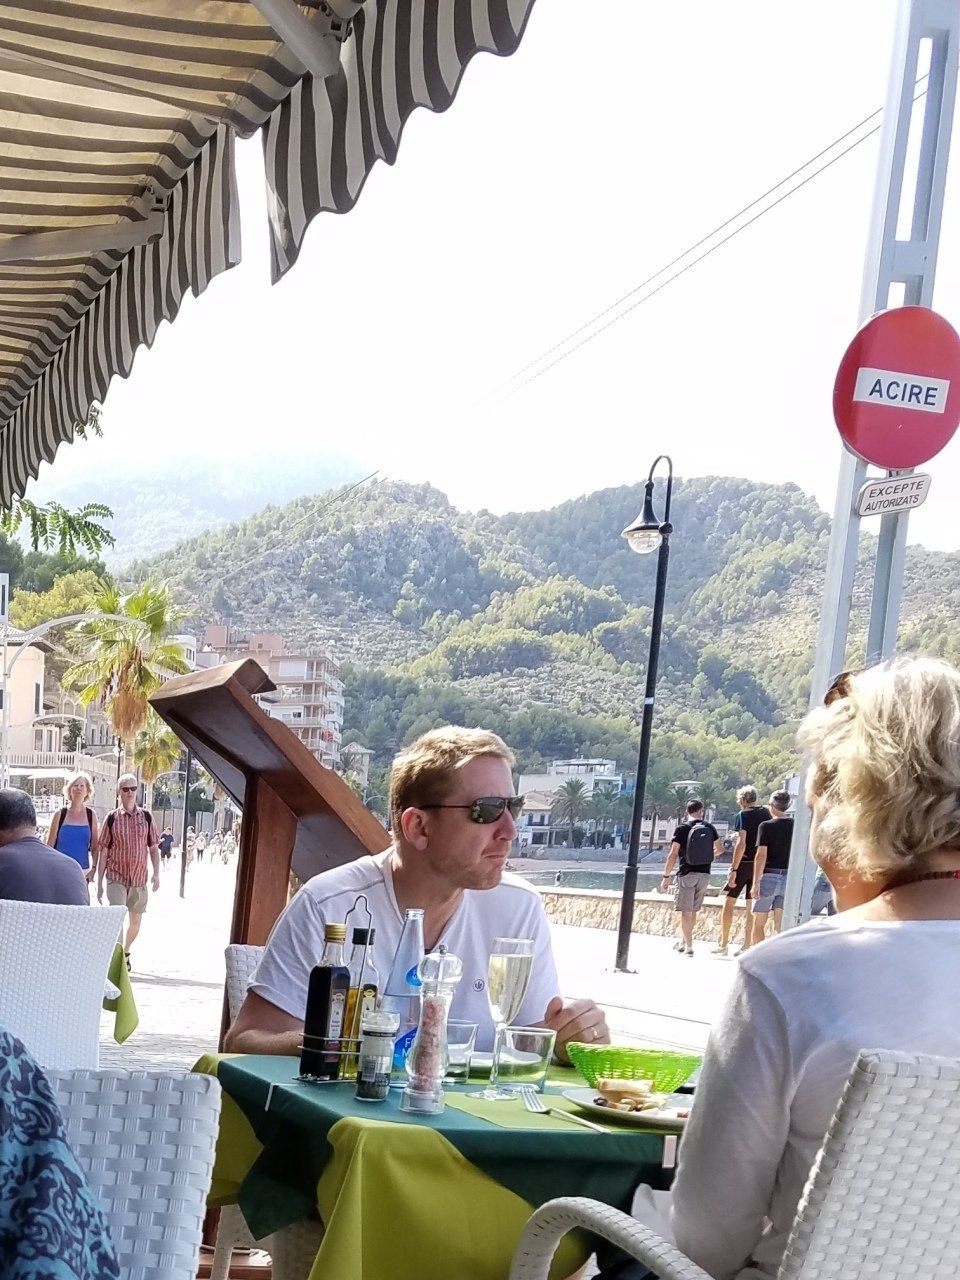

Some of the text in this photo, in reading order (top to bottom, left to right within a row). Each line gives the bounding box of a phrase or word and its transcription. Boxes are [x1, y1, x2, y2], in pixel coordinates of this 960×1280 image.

[868, 378, 938, 406] ACIRE
[868, 480, 925, 499] EXCEPTE
[864, 494, 920, 512] AUTORIZATS
